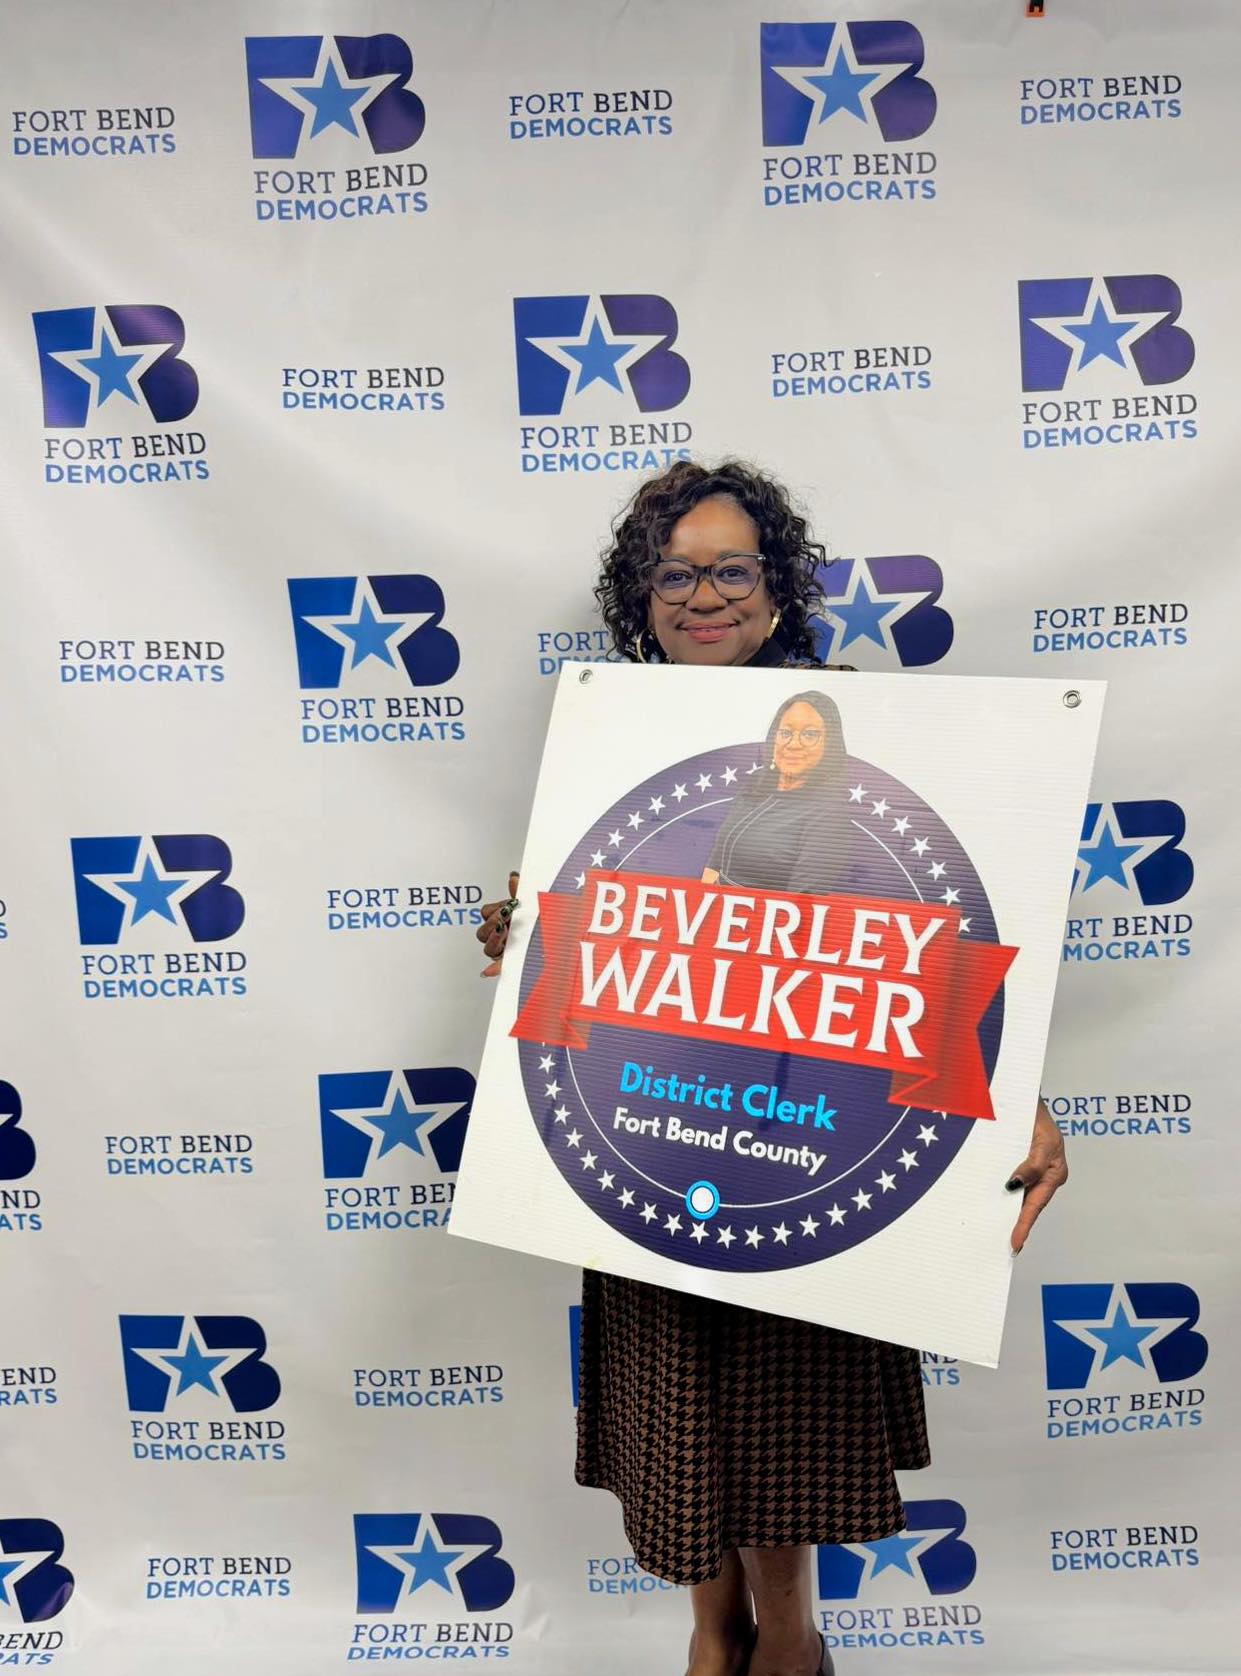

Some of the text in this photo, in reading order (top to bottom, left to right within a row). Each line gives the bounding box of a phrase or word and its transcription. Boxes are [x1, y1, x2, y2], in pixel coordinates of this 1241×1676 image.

[1021, 75, 1181, 100] FORT BEND
[509, 90, 672, 116] FORT BEND
[1021, 99, 1181, 124] DEMOCRATS
[13, 107, 174, 132] FORT BEND
[510, 115, 672, 139] DEMOCRATS
[14, 134, 175, 156] DEMOCRATS
[763, 152, 936, 180] FORT BEND
[254, 164, 427, 194] FORT BEND
[765, 180, 936, 206] DEMOCRATS
[256, 191, 427, 220] DEMOCRATS
[772, 346, 931, 374] FORT BEND
[283, 367, 444, 388] FORT BEND
[773, 370, 931, 397] DEMOCRATS
[283, 392, 444, 410] DEMOCRATS
[1023, 394, 1197, 424] FORT BEND
[521, 422, 692, 448] FORT BEND
[1023, 417, 1197, 448] DEMOCRATS
[45, 433, 205, 459] FORT BEND
[46, 458, 209, 483] DEMOCRATS
[1034, 604, 1187, 629] FORT BEND
[59, 641, 224, 660] FORT BEND
[538, 631, 609, 653] FORT
[1033, 626, 1187, 652] DEMOCRATS
[61, 664, 224, 682] DEMOCRATS
[301, 697, 463, 719] FORT BEND
[303, 722, 465, 743] DEMOCRATS
[328, 886, 482, 908] FORT BEND
[328, 908, 482, 930] DEMOCRATS
[587, 880, 945, 976] BEVERLEY
[1066, 914, 1192, 939] RT BEND
[1063, 938, 1191, 962] MOCRATS
[82, 952, 246, 975] FORT BEND
[84, 974, 246, 998] DEMOCRATS
[578, 940, 926, 1058] WALKER
[619, 1061, 838, 1131] District Clerk
[1043, 1095, 1191, 1116] ORT BEND
[1056, 1117, 1192, 1136] EMOCRATS
[105, 1135, 252, 1154] FORT BEND
[612, 1106, 827, 1177] Fort Bend County
[108, 1157, 253, 1174] DEMOCRATS
[324, 1186, 401, 1208] FORT
[1, 1367, 57, 1386] END
[354, 1365, 503, 1387] FORT BEND
[356, 1387, 503, 1406] DEMOCRATS
[1048, 1389, 1204, 1417] FORT BEND
[131, 1421, 284, 1440] FORT BEND
[1048, 1408, 1202, 1438] DEMOCRATS
[134, 1443, 285, 1460] DEMOCRATS
[1051, 1526, 1197, 1549] FORT BEND
[148, 1557, 291, 1577] FORT BEND
[588, 1557, 638, 1576] FOR
[1052, 1547, 1199, 1571] DEMOCRATS
[147, 1579, 290, 1599] DEMOCRATS
[820, 1605, 981, 1631] FORT BEND
[352, 1623, 513, 1643] FORT BEND
[348, 1646, 509, 1660] DEMOCRATS
